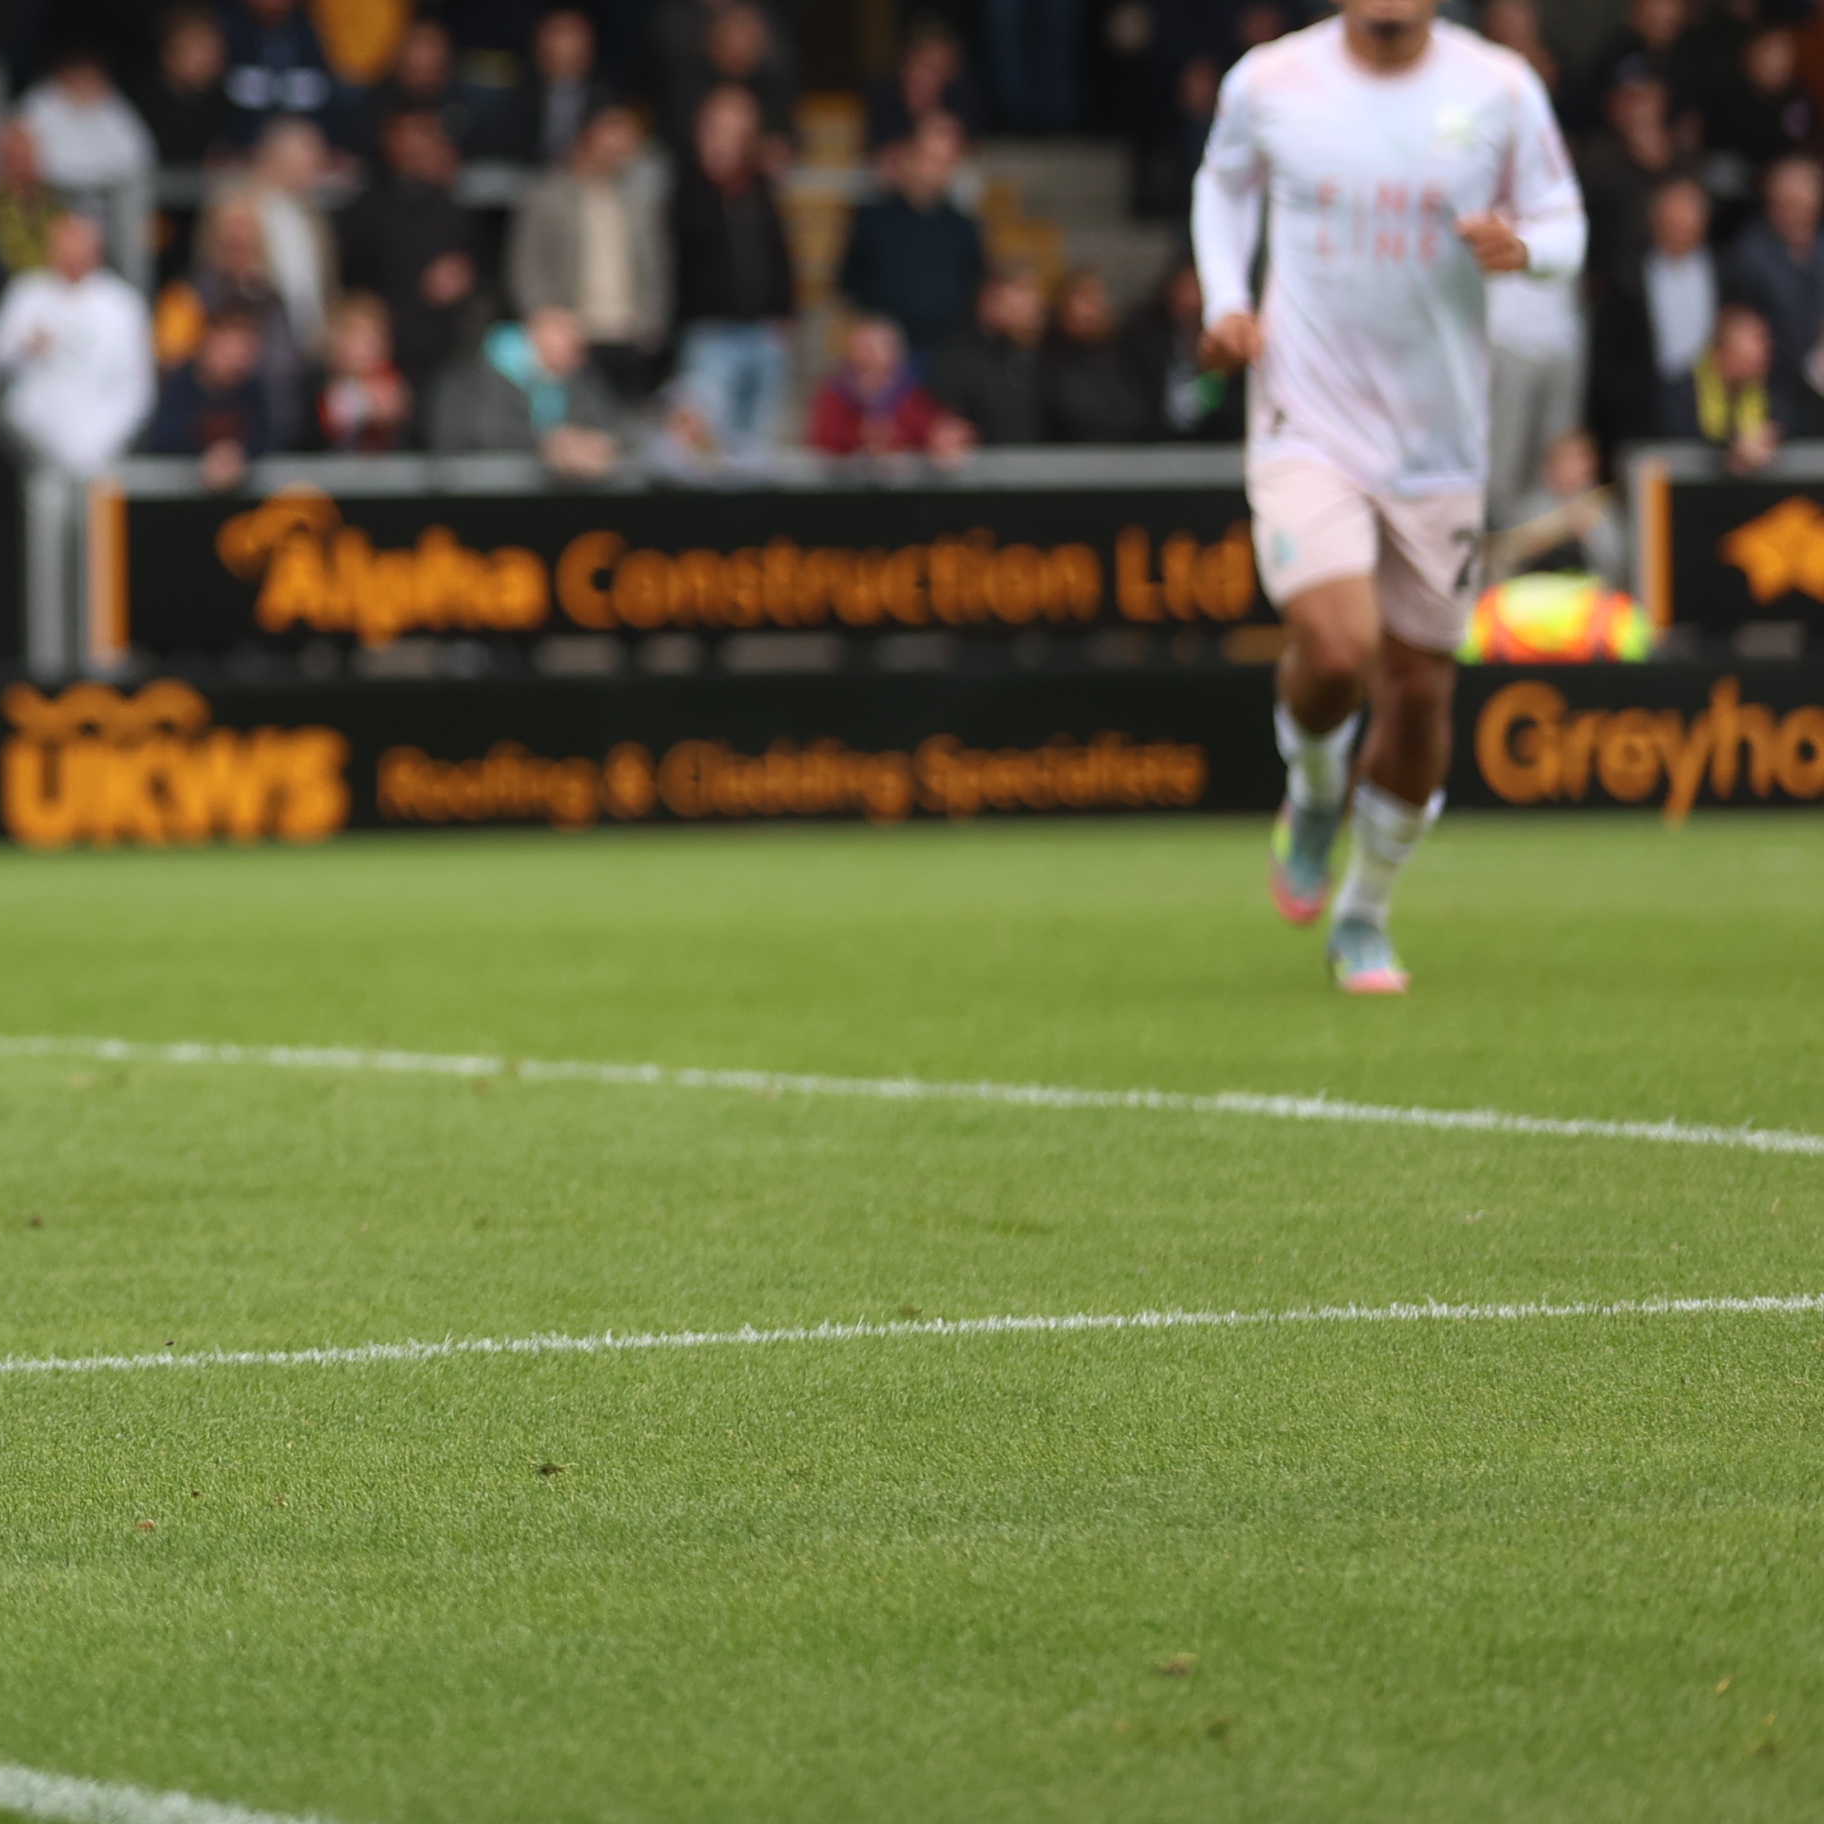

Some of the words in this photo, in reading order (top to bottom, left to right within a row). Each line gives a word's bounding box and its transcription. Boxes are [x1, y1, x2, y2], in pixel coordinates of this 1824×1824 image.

[254, 524, 549, 647] Alpha
[555, 528, 1102, 632] Construction
[1115, 522, 1254, 624] Ltd
[1474, 676, 1824, 828] Greyho
